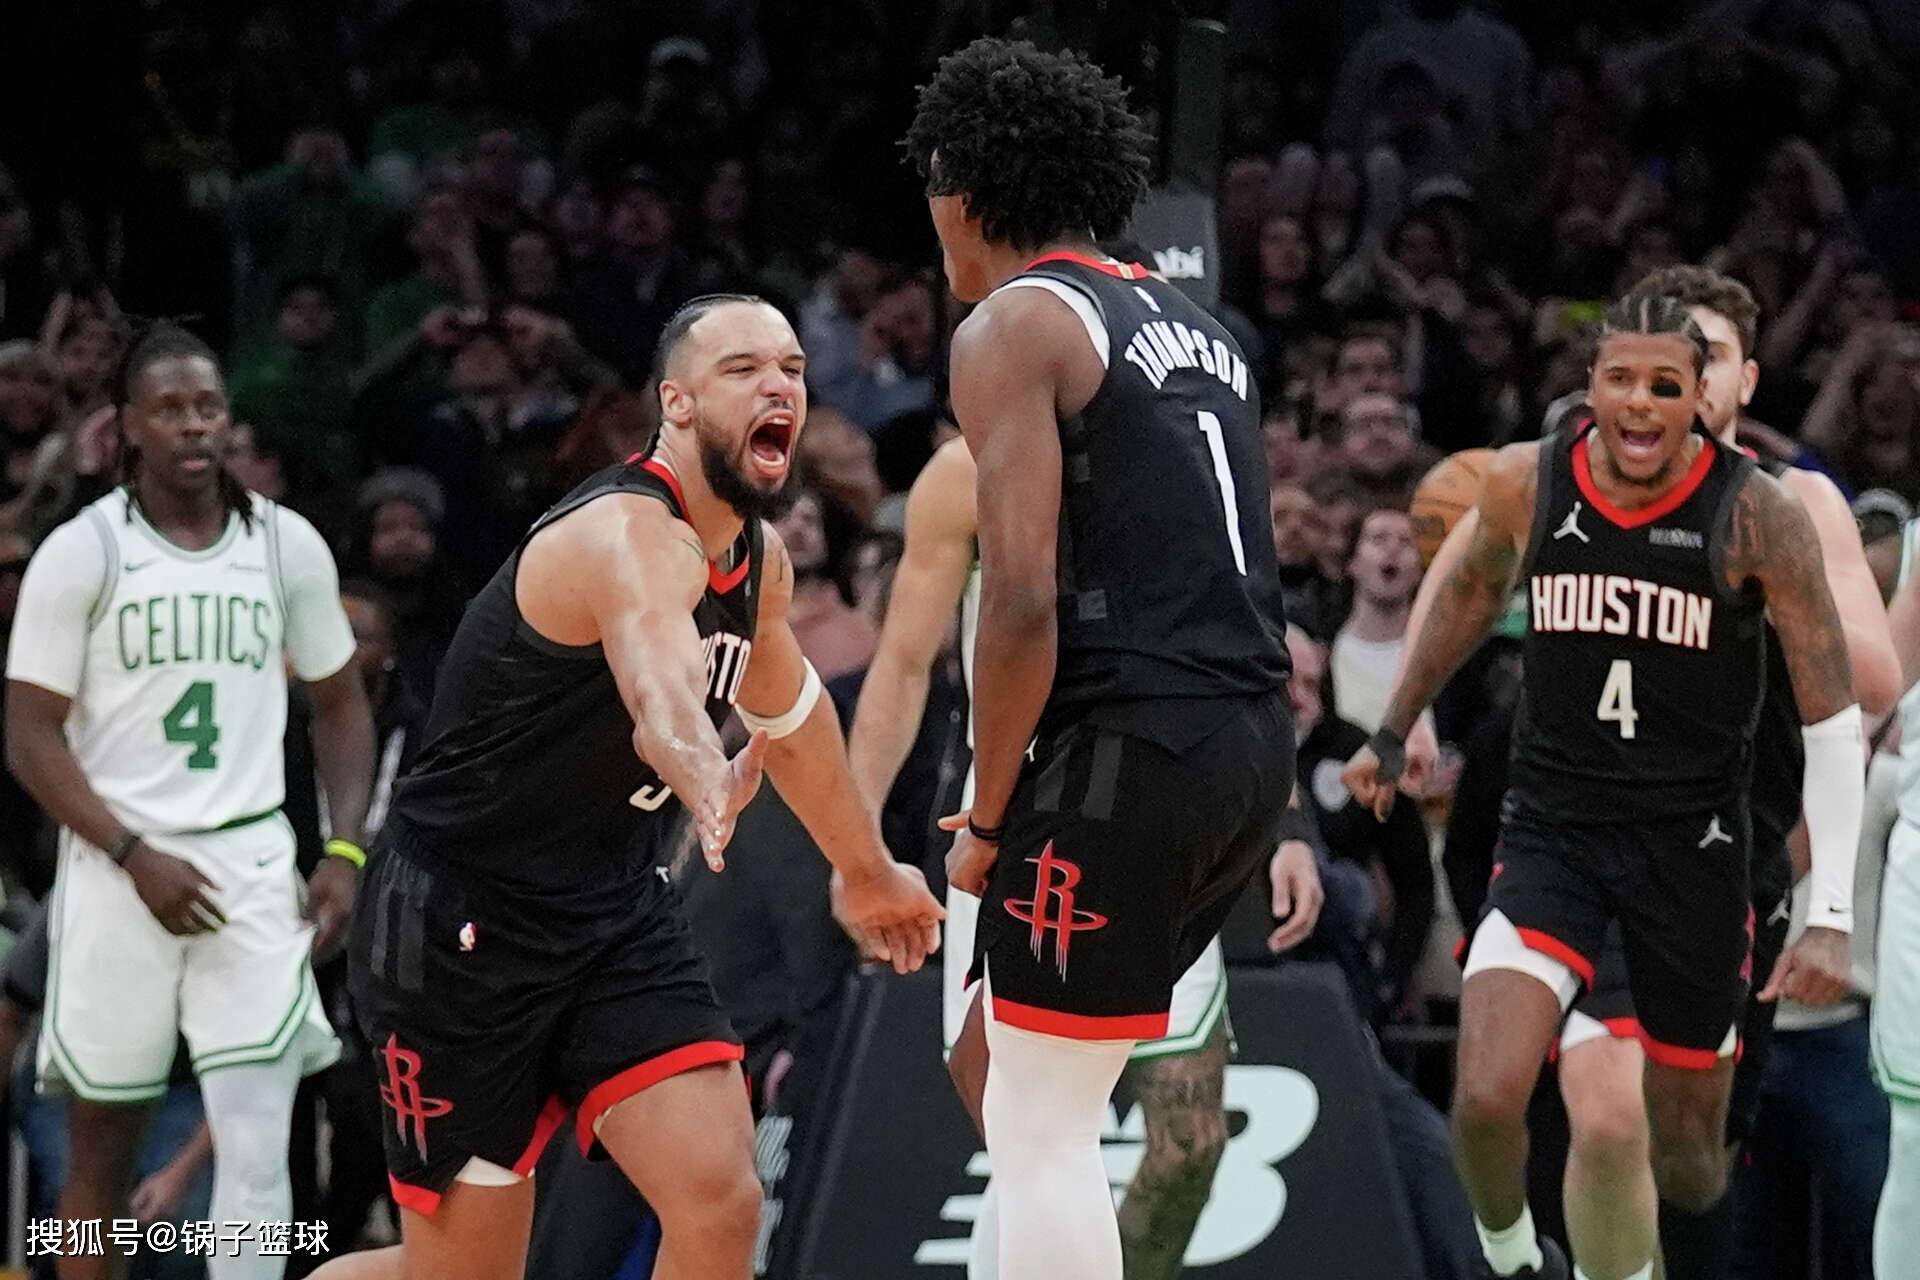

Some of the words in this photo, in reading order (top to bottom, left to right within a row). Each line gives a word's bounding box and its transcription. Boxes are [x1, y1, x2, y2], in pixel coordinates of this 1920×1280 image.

[1124, 320, 1248, 401] THOMPSON
[1197, 410, 1248, 577] 1
[118, 593, 273, 671] CELTICS
[1531, 573, 1713, 651] HOUSTON
[163, 681, 219, 769] 4
[1596, 659, 1639, 739] 4
